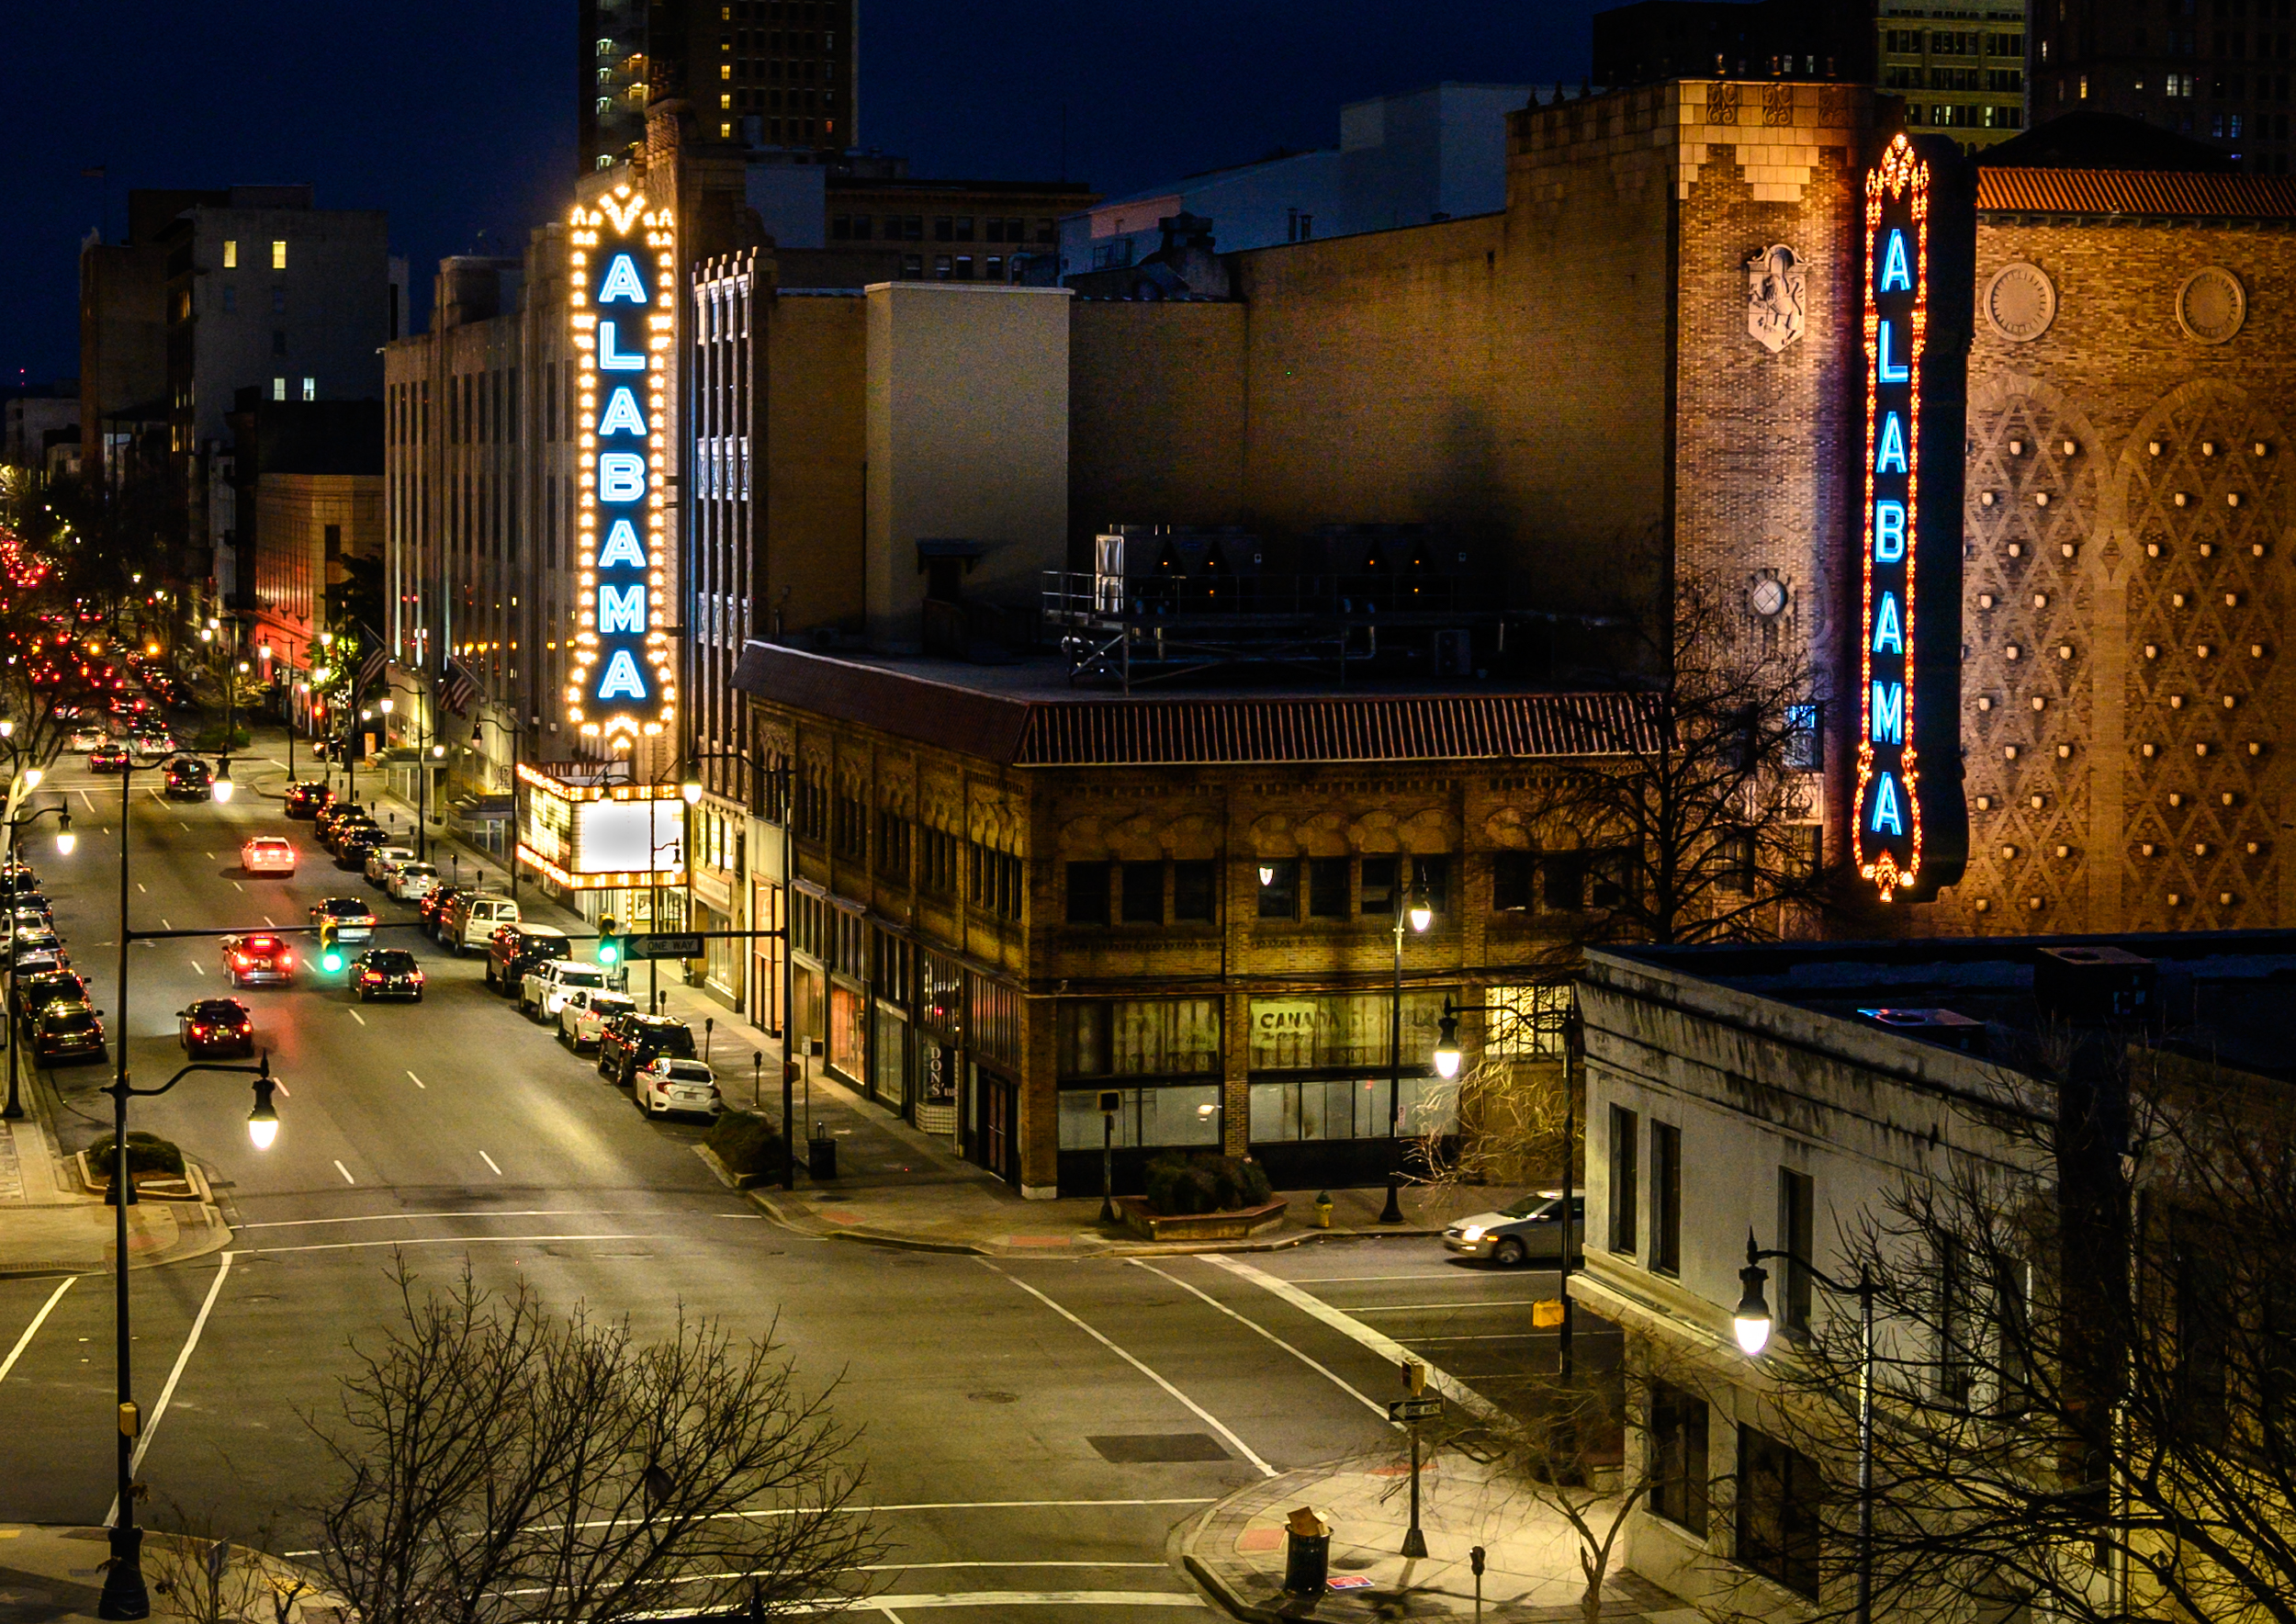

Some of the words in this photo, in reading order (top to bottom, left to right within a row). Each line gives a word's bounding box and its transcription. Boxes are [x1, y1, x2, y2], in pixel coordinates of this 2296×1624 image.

[598, 253, 648, 702] ALABAMA
[1871, 227, 1912, 837] ALABAMA
[647, 941, 668, 952] ONE
[672, 940, 694, 951] WAY
